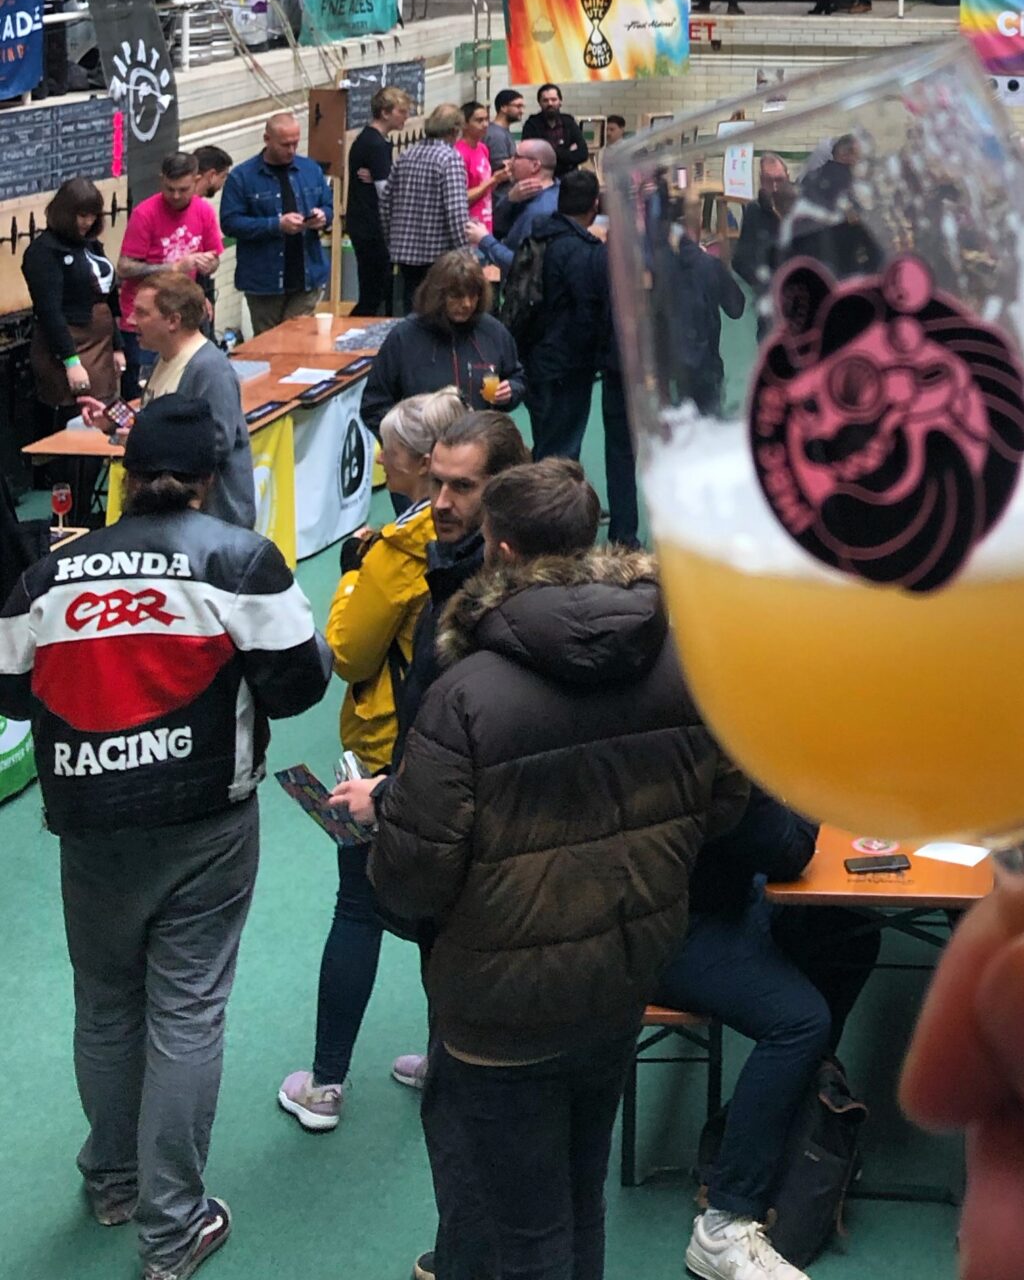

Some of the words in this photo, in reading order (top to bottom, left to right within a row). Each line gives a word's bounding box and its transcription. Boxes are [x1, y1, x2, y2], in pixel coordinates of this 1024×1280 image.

[54, 551, 192, 581] HONDA
[65, 588, 185, 632] CBR
[54, 725, 193, 776] RACING
